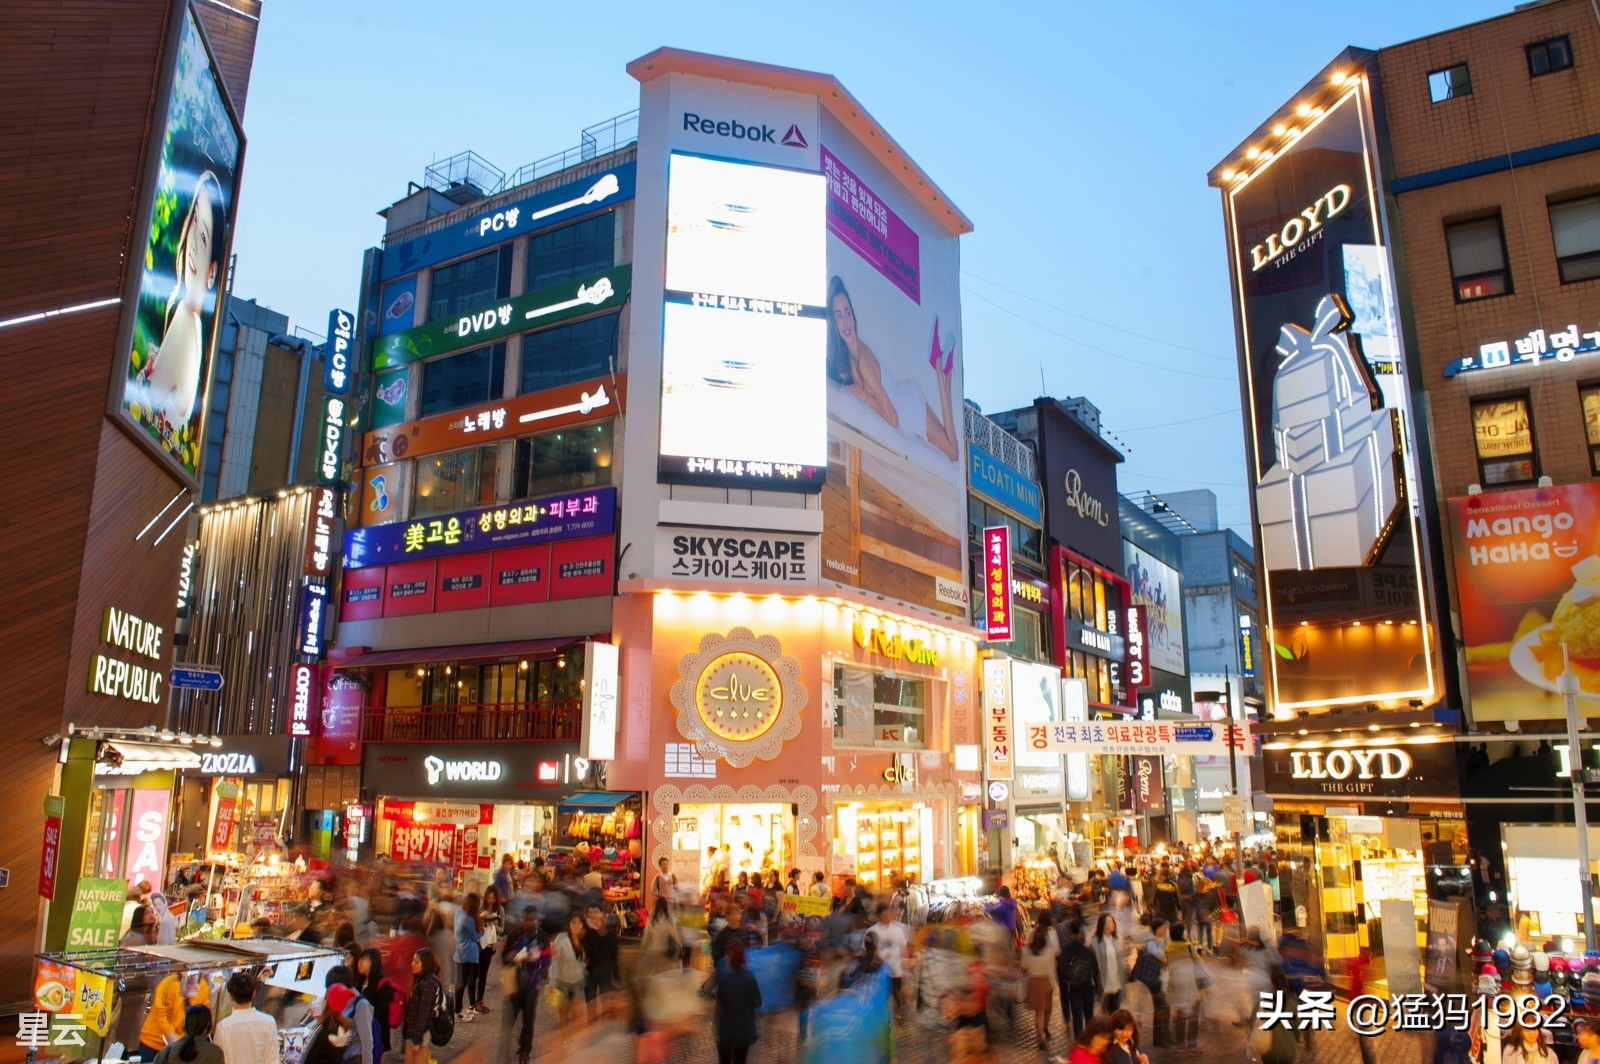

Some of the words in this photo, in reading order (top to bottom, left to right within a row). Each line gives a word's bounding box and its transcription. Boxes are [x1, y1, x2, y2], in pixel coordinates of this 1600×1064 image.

[683, 112, 776, 145] Reebok
[480, 207, 520, 236] PC방
[1250, 184, 1352, 271] LLOYD
[1274, 249, 1297, 269] THE
[1297, 228, 1324, 253] GIFT
[458, 304, 513, 337] DVD방
[463, 408, 507, 433] 노래방
[973, 455, 1014, 497] FLOATI
[1016, 481, 1038, 509] MINI
[1065, 469, 1109, 527] Roem
[1467, 502, 1521, 514] Sensational
[1523, 499, 1560, 509] Dessert
[478, 504, 538, 532] 성형외과
[549, 495, 599, 518] 피부과
[1466, 512, 1574, 539] Mango
[672, 536, 805, 560] SKYSCAPE
[1470, 542, 1550, 566] HaHa
[672, 557, 806, 580] 스카이스케이프
[826, 558, 859, 576] reebok.co.kr
[938, 583, 961, 602] Reebok
[106, 606, 163, 660] NATURE
[93, 654, 163, 704] REPUBLIC
[710, 672, 770, 702] clue
[293, 666, 310, 720] COFFEE
[1030, 725, 1048, 749] 경
[1054, 725, 1077, 743] 전국
[1081, 725, 1104, 743] 최초
[1107, 725, 1176, 744] 의료관광특
[201, 753, 256, 773] ZIOZIA
[446, 761, 502, 781] WORLD
[1290, 748, 1412, 779] LLOYD
[1137, 759, 1153, 803] Roem
[1321, 783, 1344, 792] THE
[1346, 783, 1373, 793] GIFT
[219, 807, 232, 820] SALE
[46, 826, 58, 845] SALE
[216, 822, 228, 843] 50
[44, 847, 55, 879] 50
[76, 901, 99, 912] DAY
[79, 889, 122, 902] NATURE
[69, 927, 115, 948] SALE
